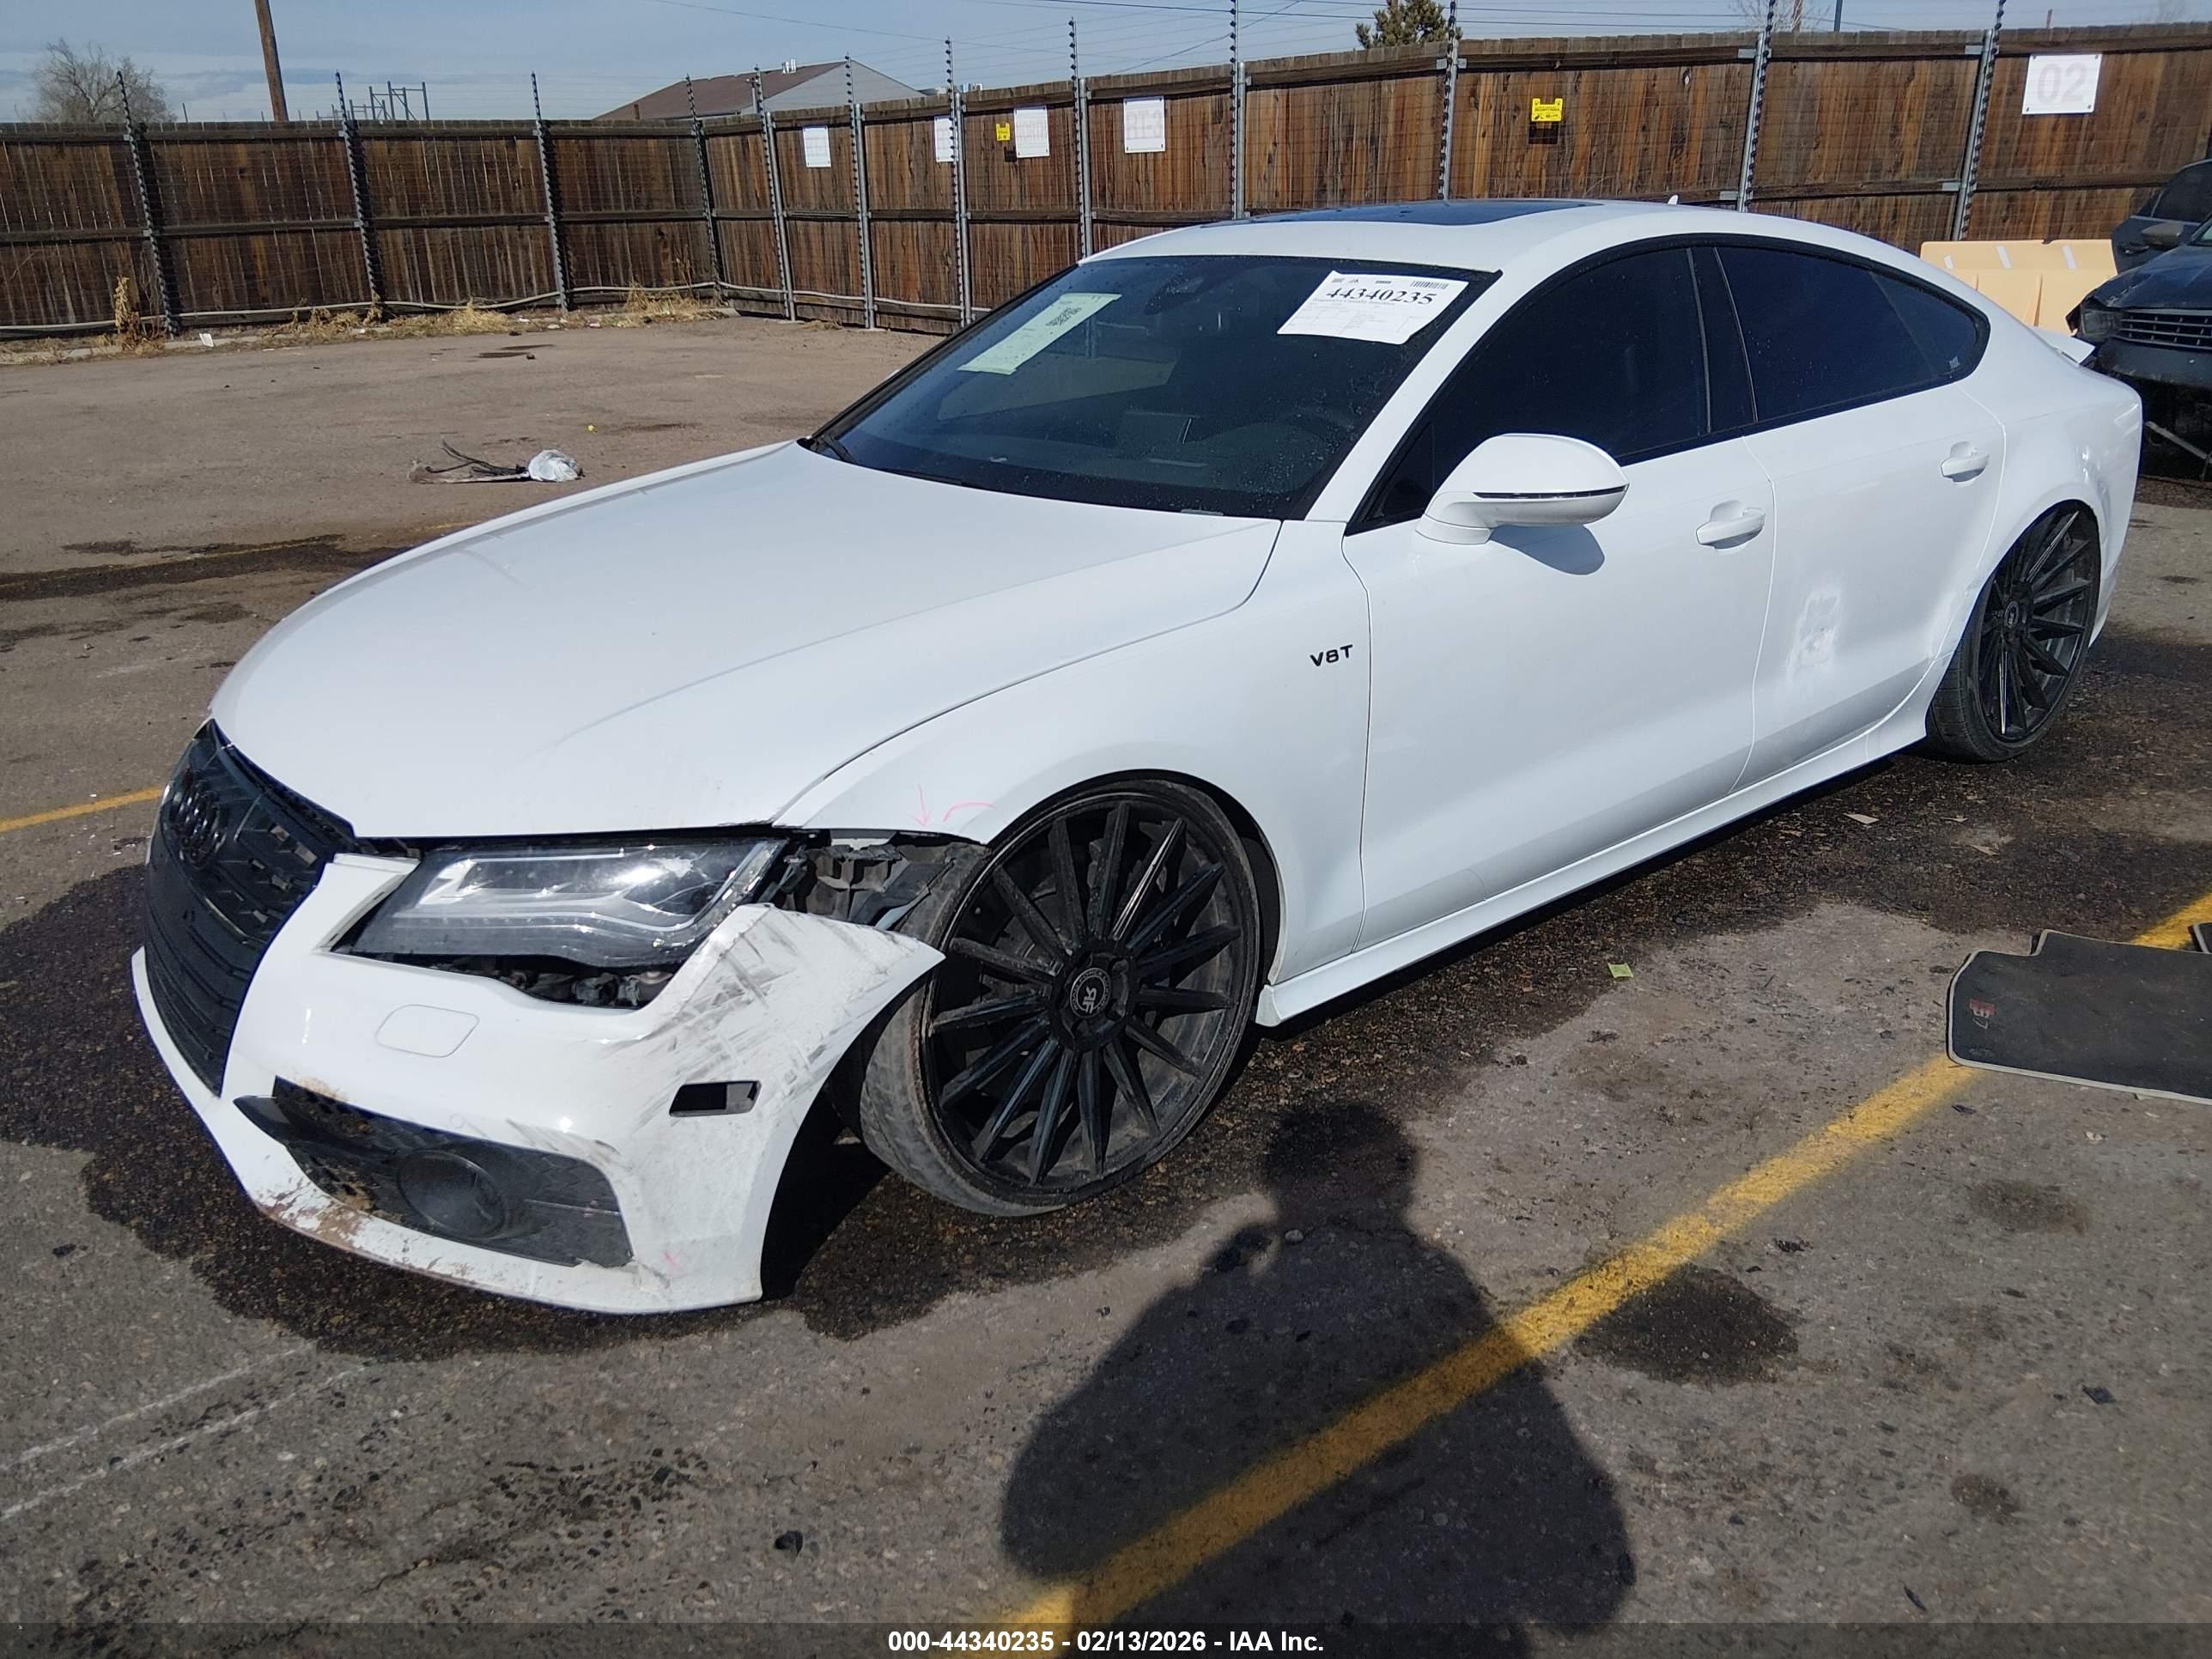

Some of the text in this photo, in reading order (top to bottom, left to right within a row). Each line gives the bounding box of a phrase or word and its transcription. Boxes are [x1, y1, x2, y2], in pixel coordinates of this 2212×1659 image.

[2038, 62, 2087, 104] 02
[1326, 288, 1437, 305] 44340235
[1310, 644, 1353, 666] V8T
